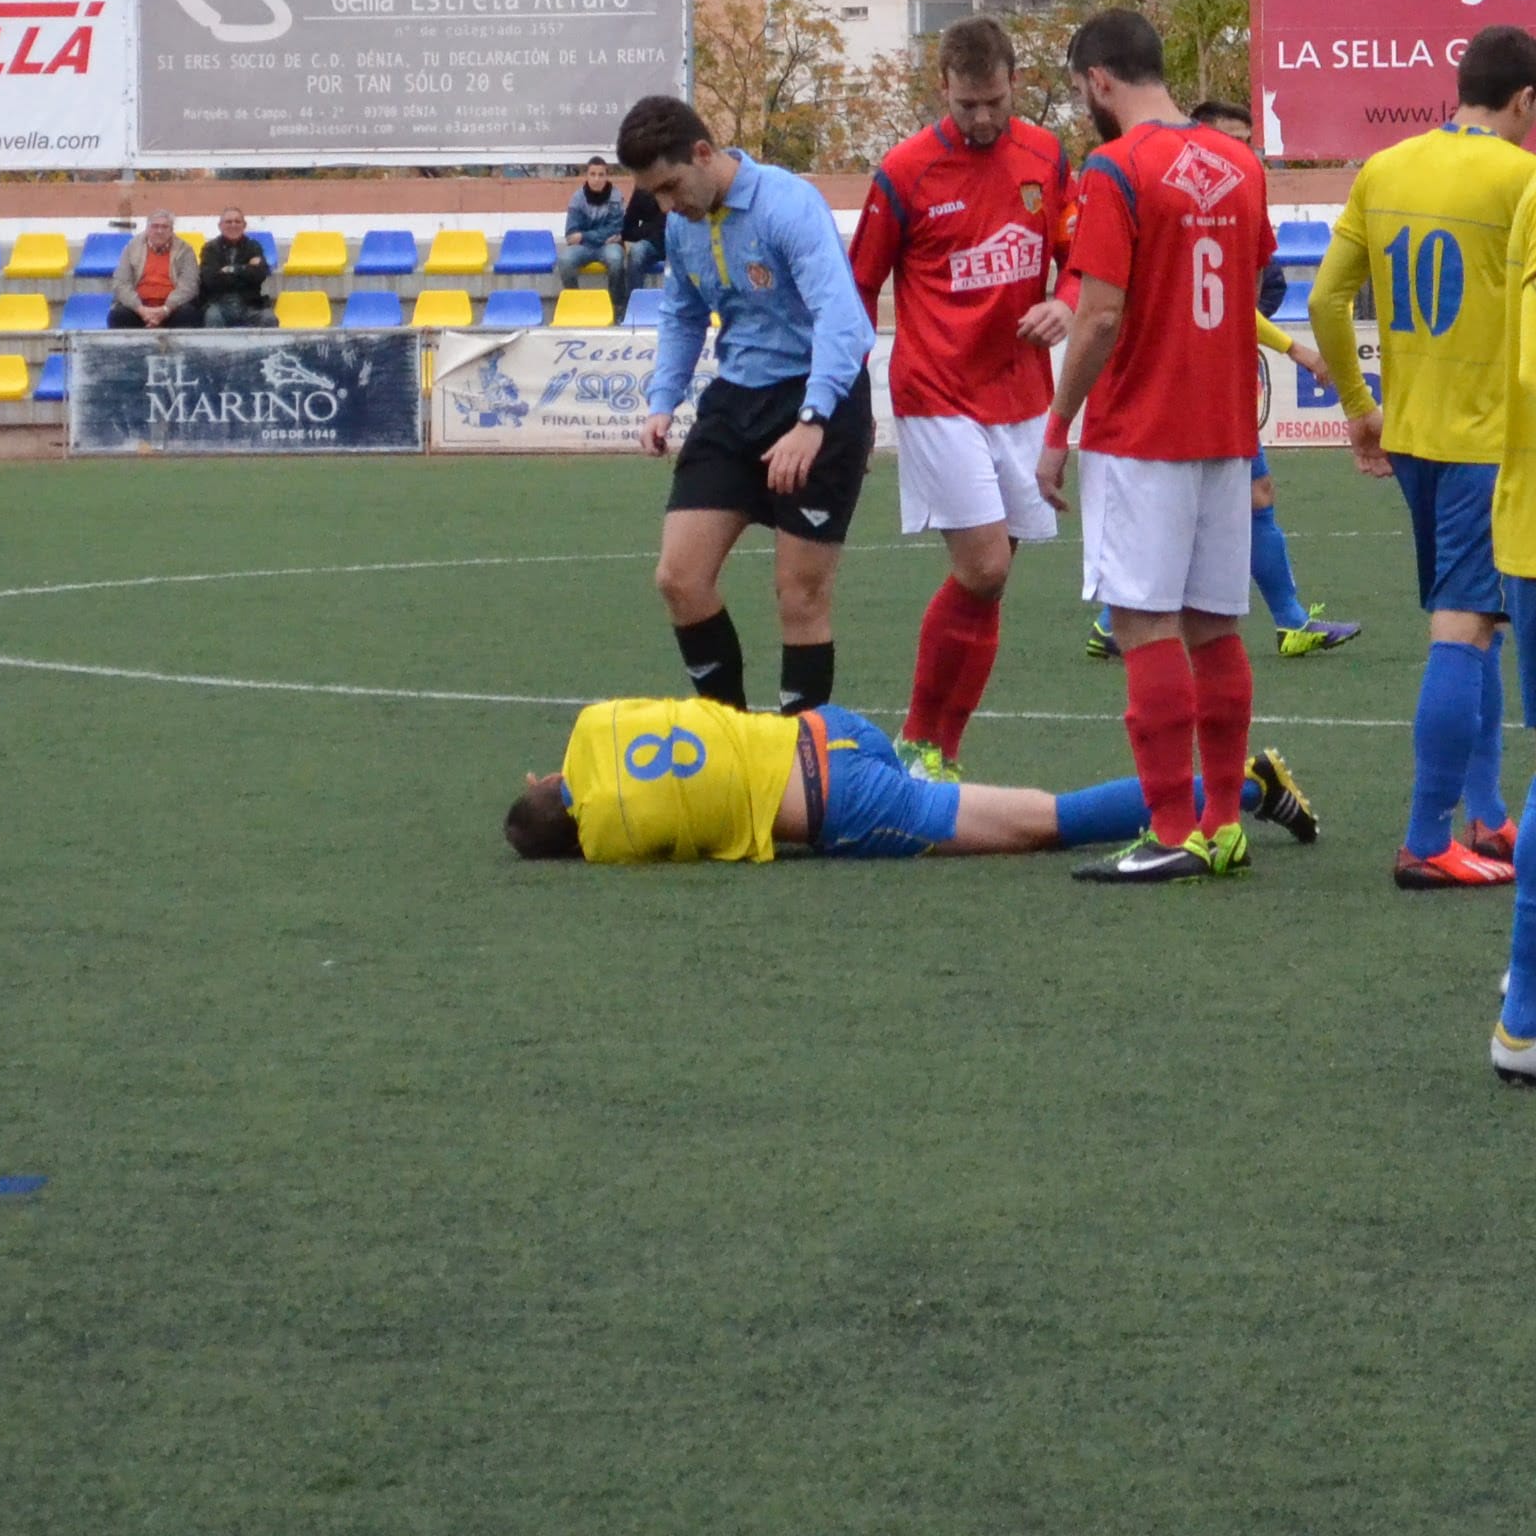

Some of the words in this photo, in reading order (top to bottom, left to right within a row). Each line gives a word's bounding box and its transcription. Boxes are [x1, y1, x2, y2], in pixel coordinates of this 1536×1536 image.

[157, 54, 174, 70] SI
[183, 53, 221, 71] ERES
[230, 52, 276, 70] SOCIO
[284, 52, 302, 69] DE
[423, 51, 440, 66] TU
[449, 46, 550, 66] DECLARACIÓN
[559, 49, 577, 64] DE
[588, 49, 608, 64] LA
[616, 47, 666, 64] RENTA
[1277, 40, 1322, 69] LA
[1332, 38, 1434, 68] SELLA
[307, 74, 343, 95] POR
[356, 73, 392, 94] TAN
[404, 69, 453, 94] SÓLO
[465, 72, 490, 93] 20
[501, 72, 515, 93] €
[1192, 236, 1225, 331] 6
[1383, 225, 1464, 338] 10
[145, 354, 199, 387] EL
[145, 390, 339, 424] MARINO
[541, 415, 594, 426] FINAL
[597, 415, 630, 426] LAS
[262, 429, 305, 441] DESDE
[308, 429, 337, 440] 1949
[624, 725, 707, 782] 8
